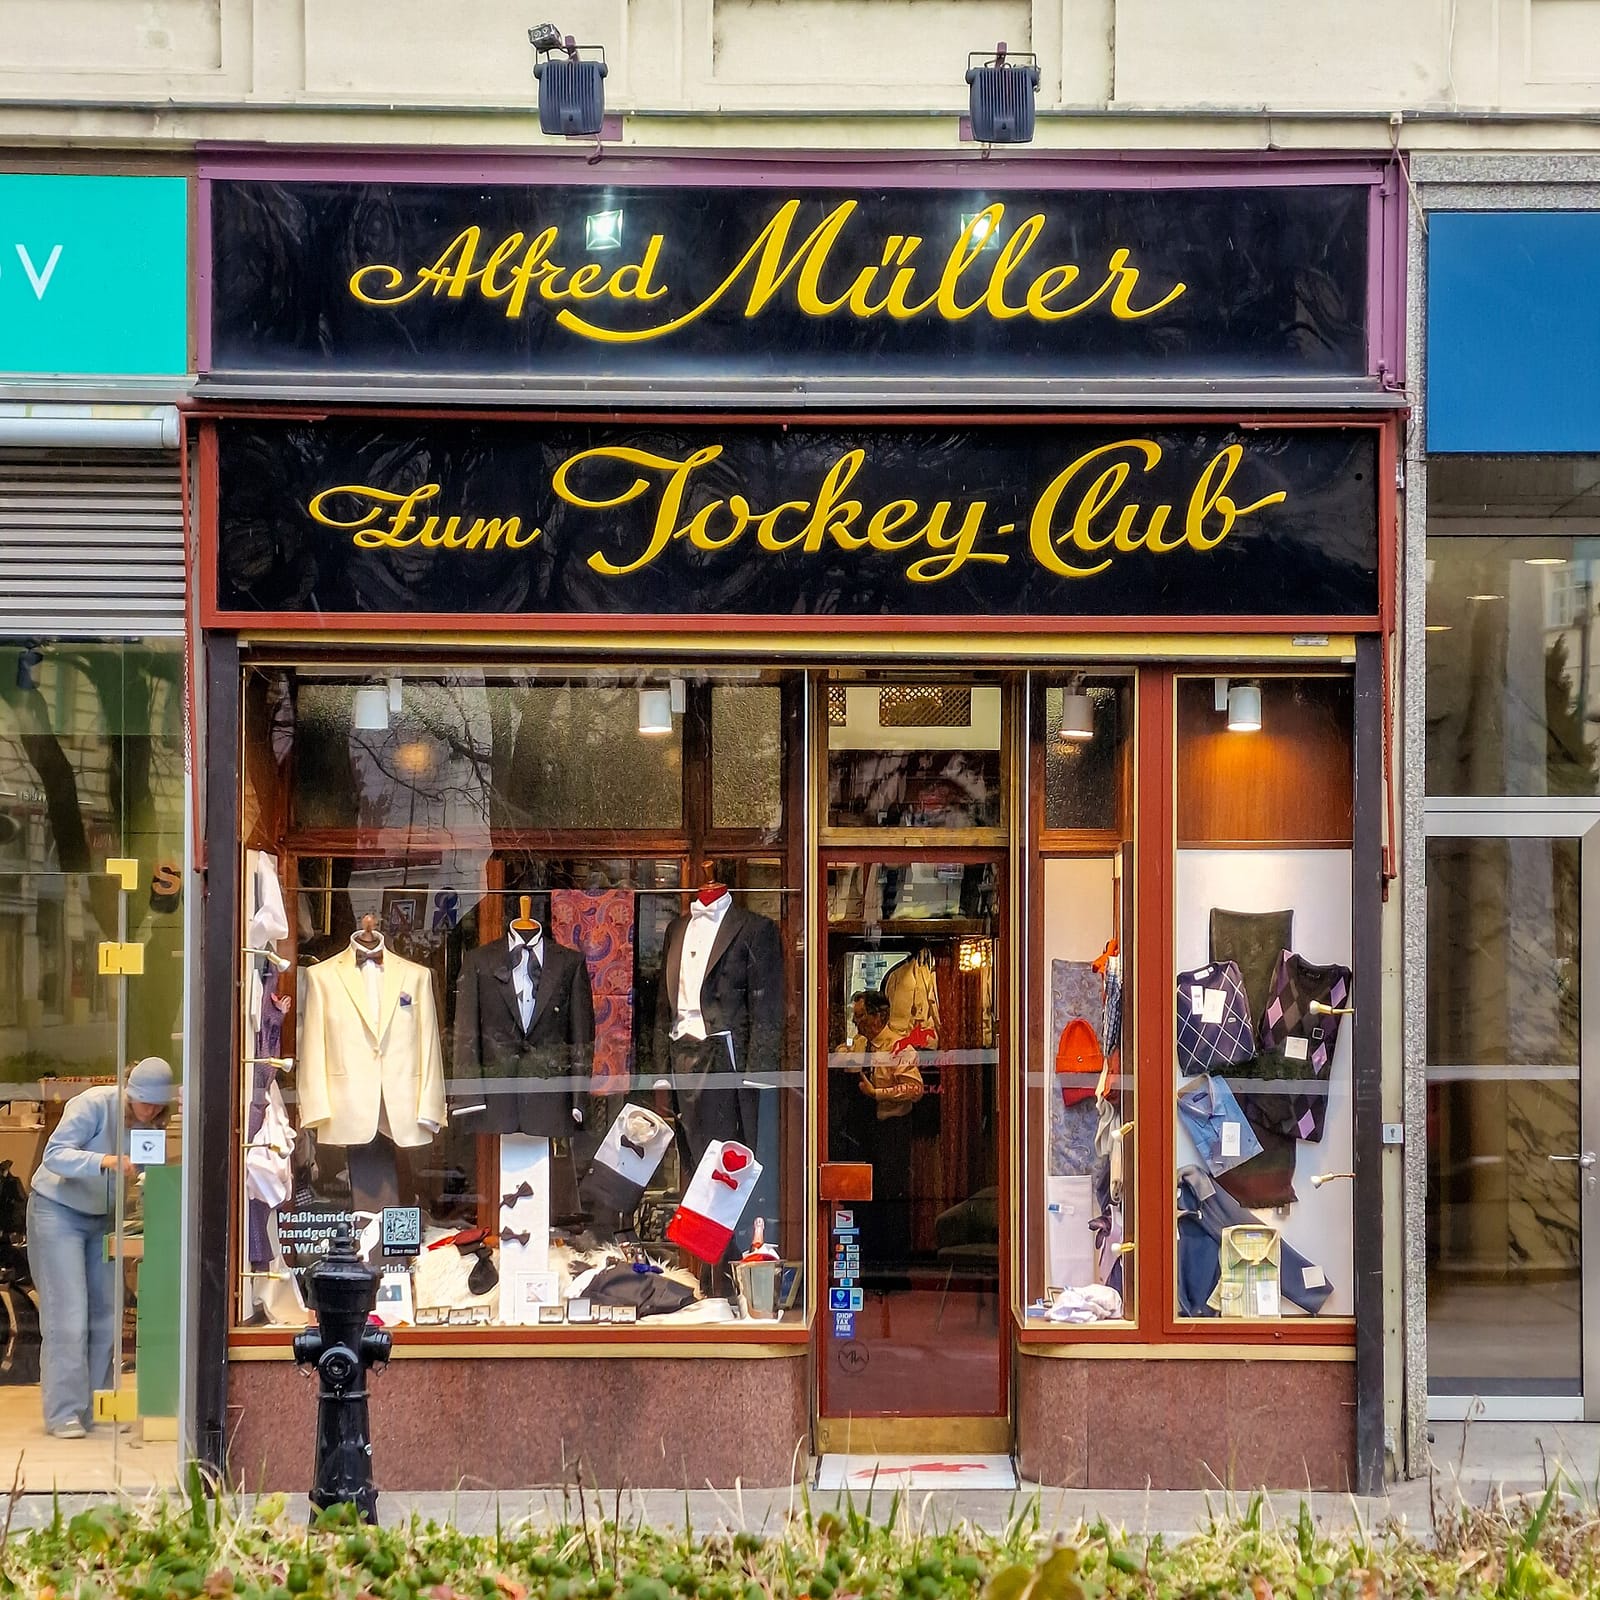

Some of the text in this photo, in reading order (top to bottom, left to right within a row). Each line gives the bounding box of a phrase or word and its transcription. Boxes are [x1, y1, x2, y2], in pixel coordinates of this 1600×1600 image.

[0, 243, 64, 301] V
[348, 198, 1187, 343] Alfred Müller
[308, 438, 1288, 584] Zum Jockey-Club
[278, 1211, 361, 1223] Maßhemden
[278, 1227, 368, 1241] handgefeig
[278, 1241, 331, 1254] in Wien
